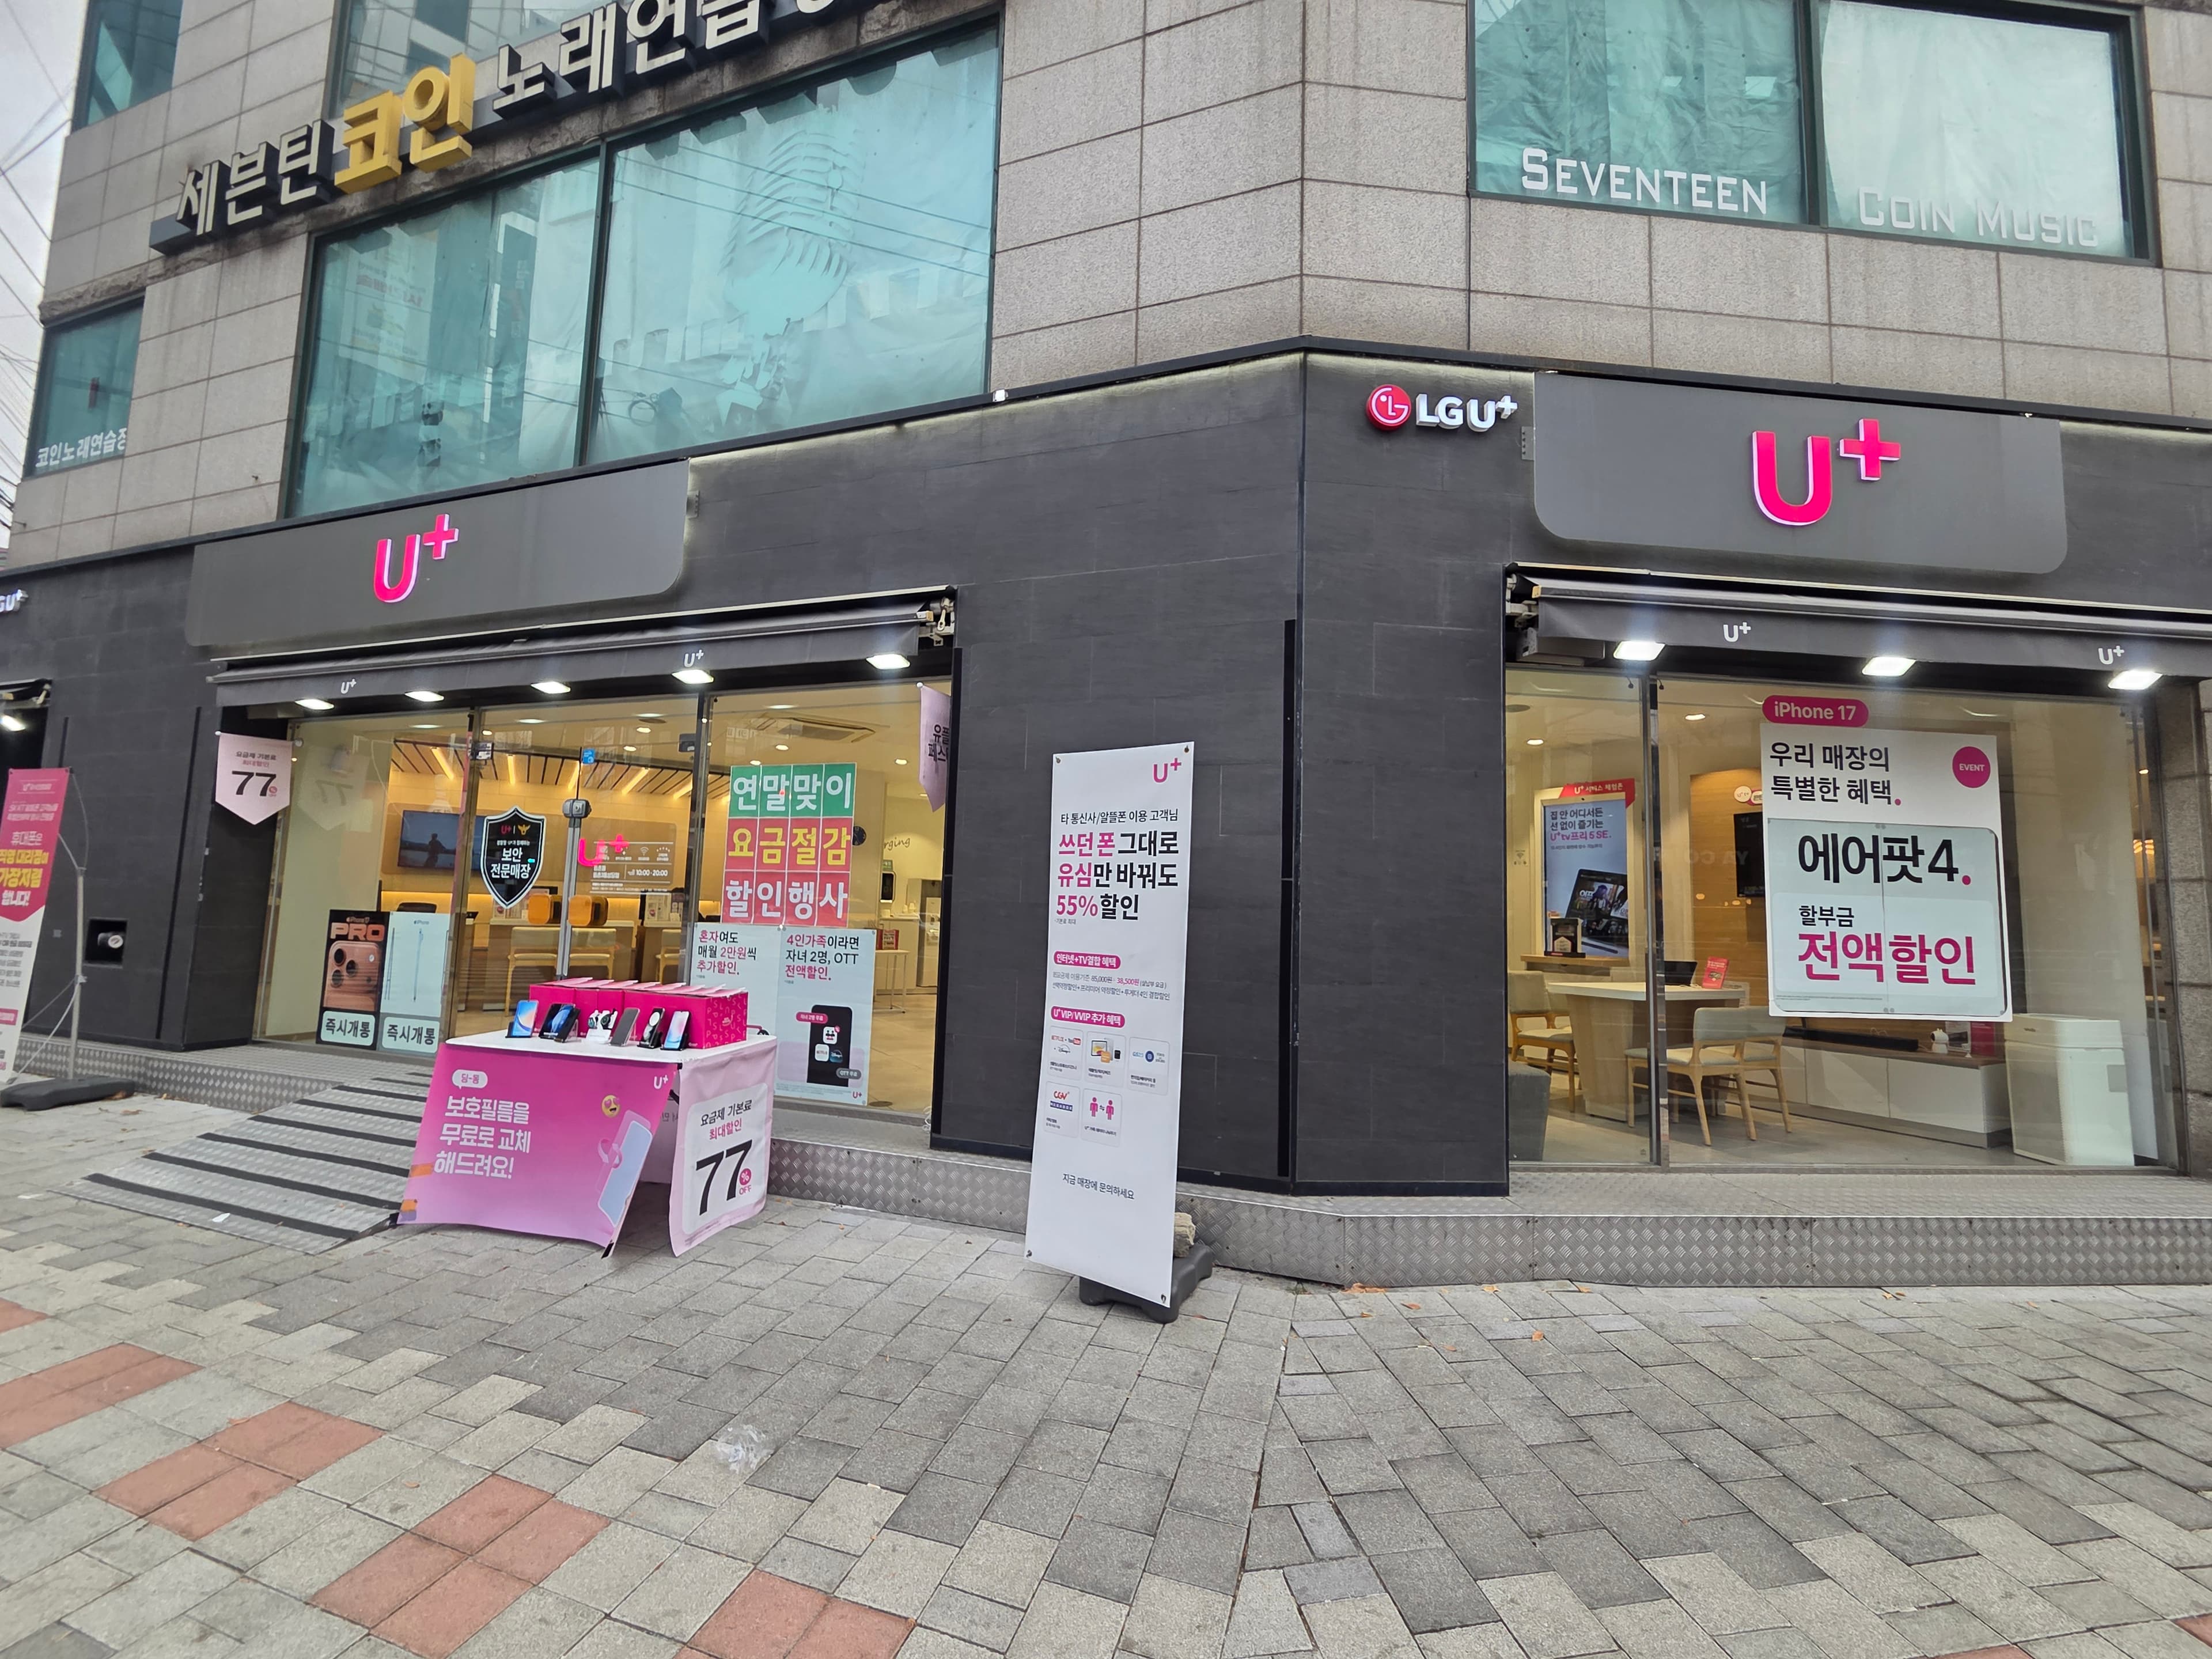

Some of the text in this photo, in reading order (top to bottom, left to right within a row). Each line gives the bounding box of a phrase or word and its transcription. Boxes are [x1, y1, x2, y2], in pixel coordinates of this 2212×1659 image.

[176, 119, 335, 235] 세븐틴
[334, 52, 476, 194] 코인
[1522, 147, 1767, 215] SEVENTEEN
[1858, 185, 2100, 249] COIN MUSIC
[1752, 418, 1901, 527] U+
[373, 513, 459, 603] U+
[1723, 622, 1751, 643] U+
[683, 649, 704, 668] U+
[2097, 645, 2126, 665] U+
[340, 678, 357, 694] U+
[1774, 700, 1857, 721] iPhone 17
[1770, 742, 1890, 772] 우리 매장의
[1959, 763, 1985, 772] EVENT
[1153, 757, 1182, 783] U+
[232, 770, 277, 796] 77
[733, 772, 851, 812] 연말맞이
[1771, 775, 1902, 806] 특별한 혜택.
[1060, 812, 1069, 825] 타
[1128, 809, 1148, 823] 이용
[1149, 808, 1179, 822] 고객님
[1550, 807, 1604, 820] 집 안 어디서든
[1550, 819, 1604, 831] 선 없이 즐기는
[501, 847, 523, 862] 보안
[728, 827, 851, 866] 요금절감
[490, 863, 531, 880] 전문매장
[1058, 862, 1179, 889] 유심만 바꿔도
[726, 880, 849, 920] 할인행사
[1056, 893, 1139, 921] 55% 할인
[1798, 905, 1855, 928] 할부금
[330, 922, 385, 941] PRO
[698, 929, 738, 944] 혼자여도
[786, 934, 860, 950] 4인가족이라면
[698, 945, 757, 960] 매월 2만원씩
[785, 949, 859, 965] 자녀 2명, OTT
[1101, 956, 1116, 968] 혜택
[1798, 931, 1976, 986] 전액할인
[696, 960, 740, 975] 추가할인.
[785, 964, 831, 981] 전액할인.
[325, 1018, 370, 1039] 즉시개통
[1091, 1013, 1106, 1024] 추가
[1107, 1016, 1121, 1026] 혜택
[387, 1024, 436, 1046] 즉시개통
[654, 1073, 669, 1090] U+
[445, 1094, 530, 1124] 보호필름을
[700, 1107, 725, 1127] 요금제
[728, 1099, 752, 1117] 기본료
[439, 1124, 532, 1154] 무료로 교체
[709, 1118, 742, 1140] 최대할인
[434, 1150, 514, 1180] 해드려요!
[695, 1139, 752, 1216] 77
[1062, 1173, 1135, 1200] 지금 매장에 문의하세요
